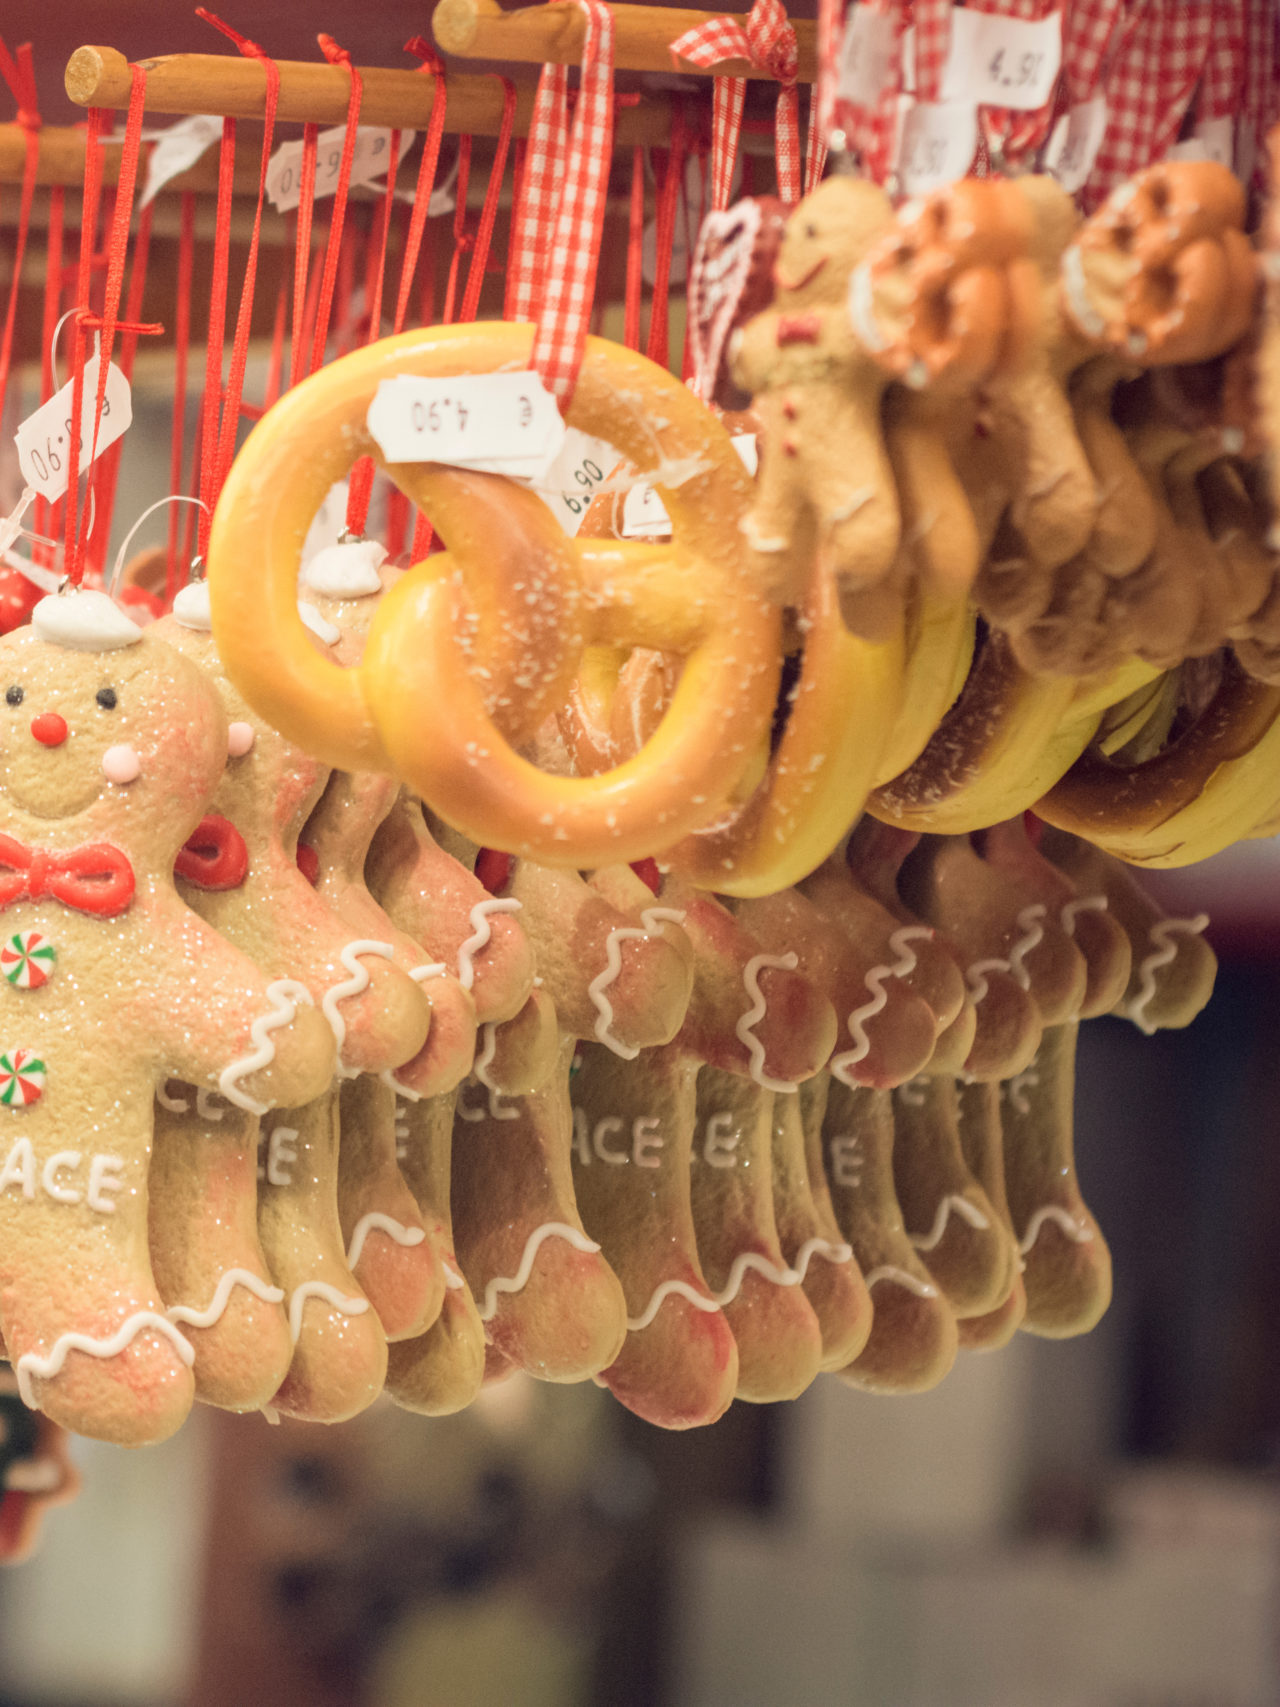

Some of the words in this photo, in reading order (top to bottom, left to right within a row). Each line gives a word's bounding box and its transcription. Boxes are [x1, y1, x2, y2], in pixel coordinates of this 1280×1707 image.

[281, 150, 341, 194] 6.0
[412, 398, 469, 432] 4.90
[519, 396, 532, 427] €
[562, 459, 604, 515] 6.90
